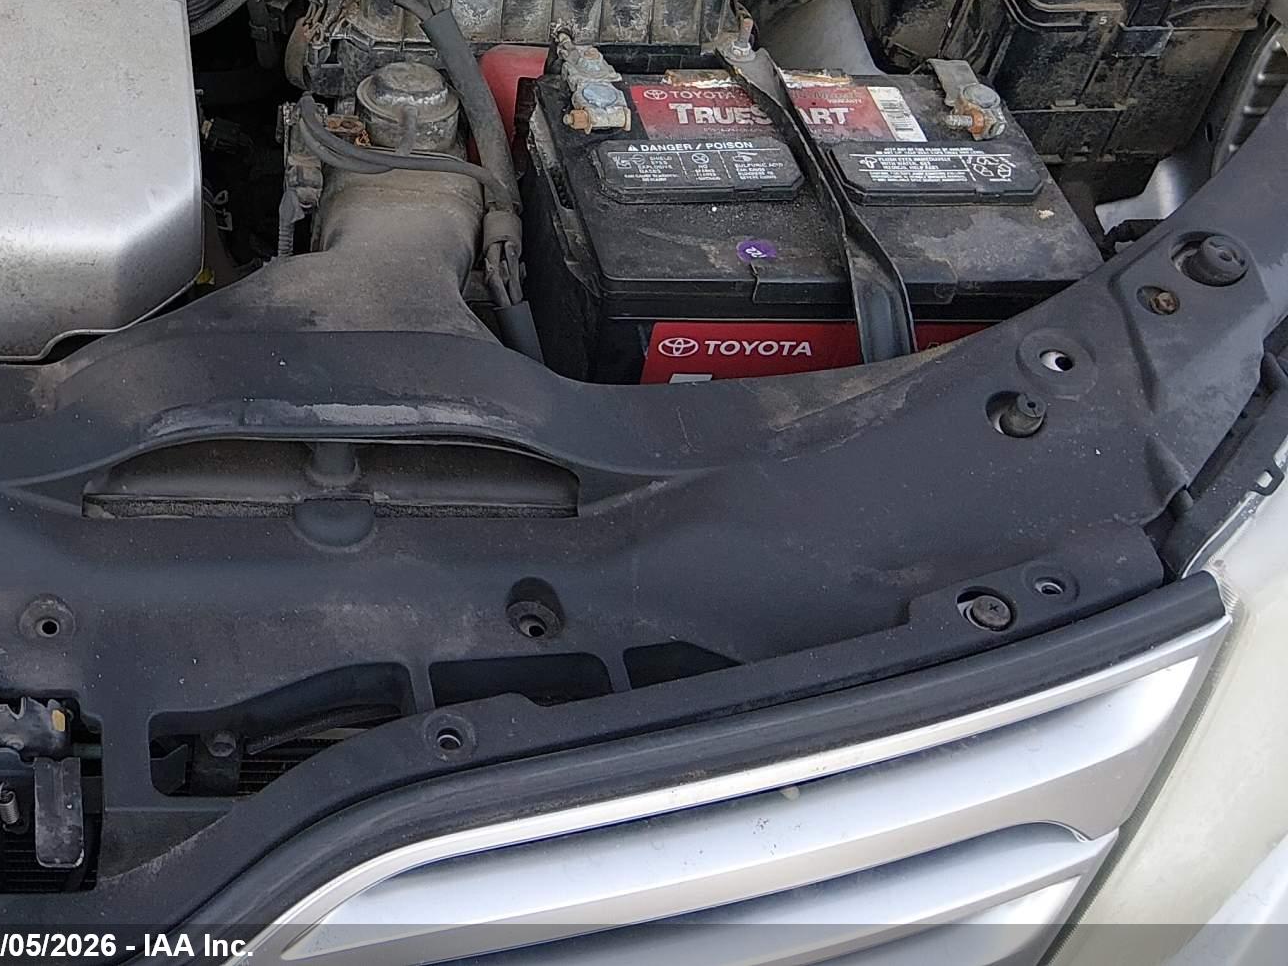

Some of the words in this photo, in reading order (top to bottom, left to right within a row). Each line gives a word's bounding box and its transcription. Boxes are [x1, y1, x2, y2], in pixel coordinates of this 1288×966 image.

[669, 90, 736, 100] TOYOTA
[640, 143, 693, 152] DANGER
[707, 141, 754, 150] POISON
[704, 340, 813, 356] TOYOTA
